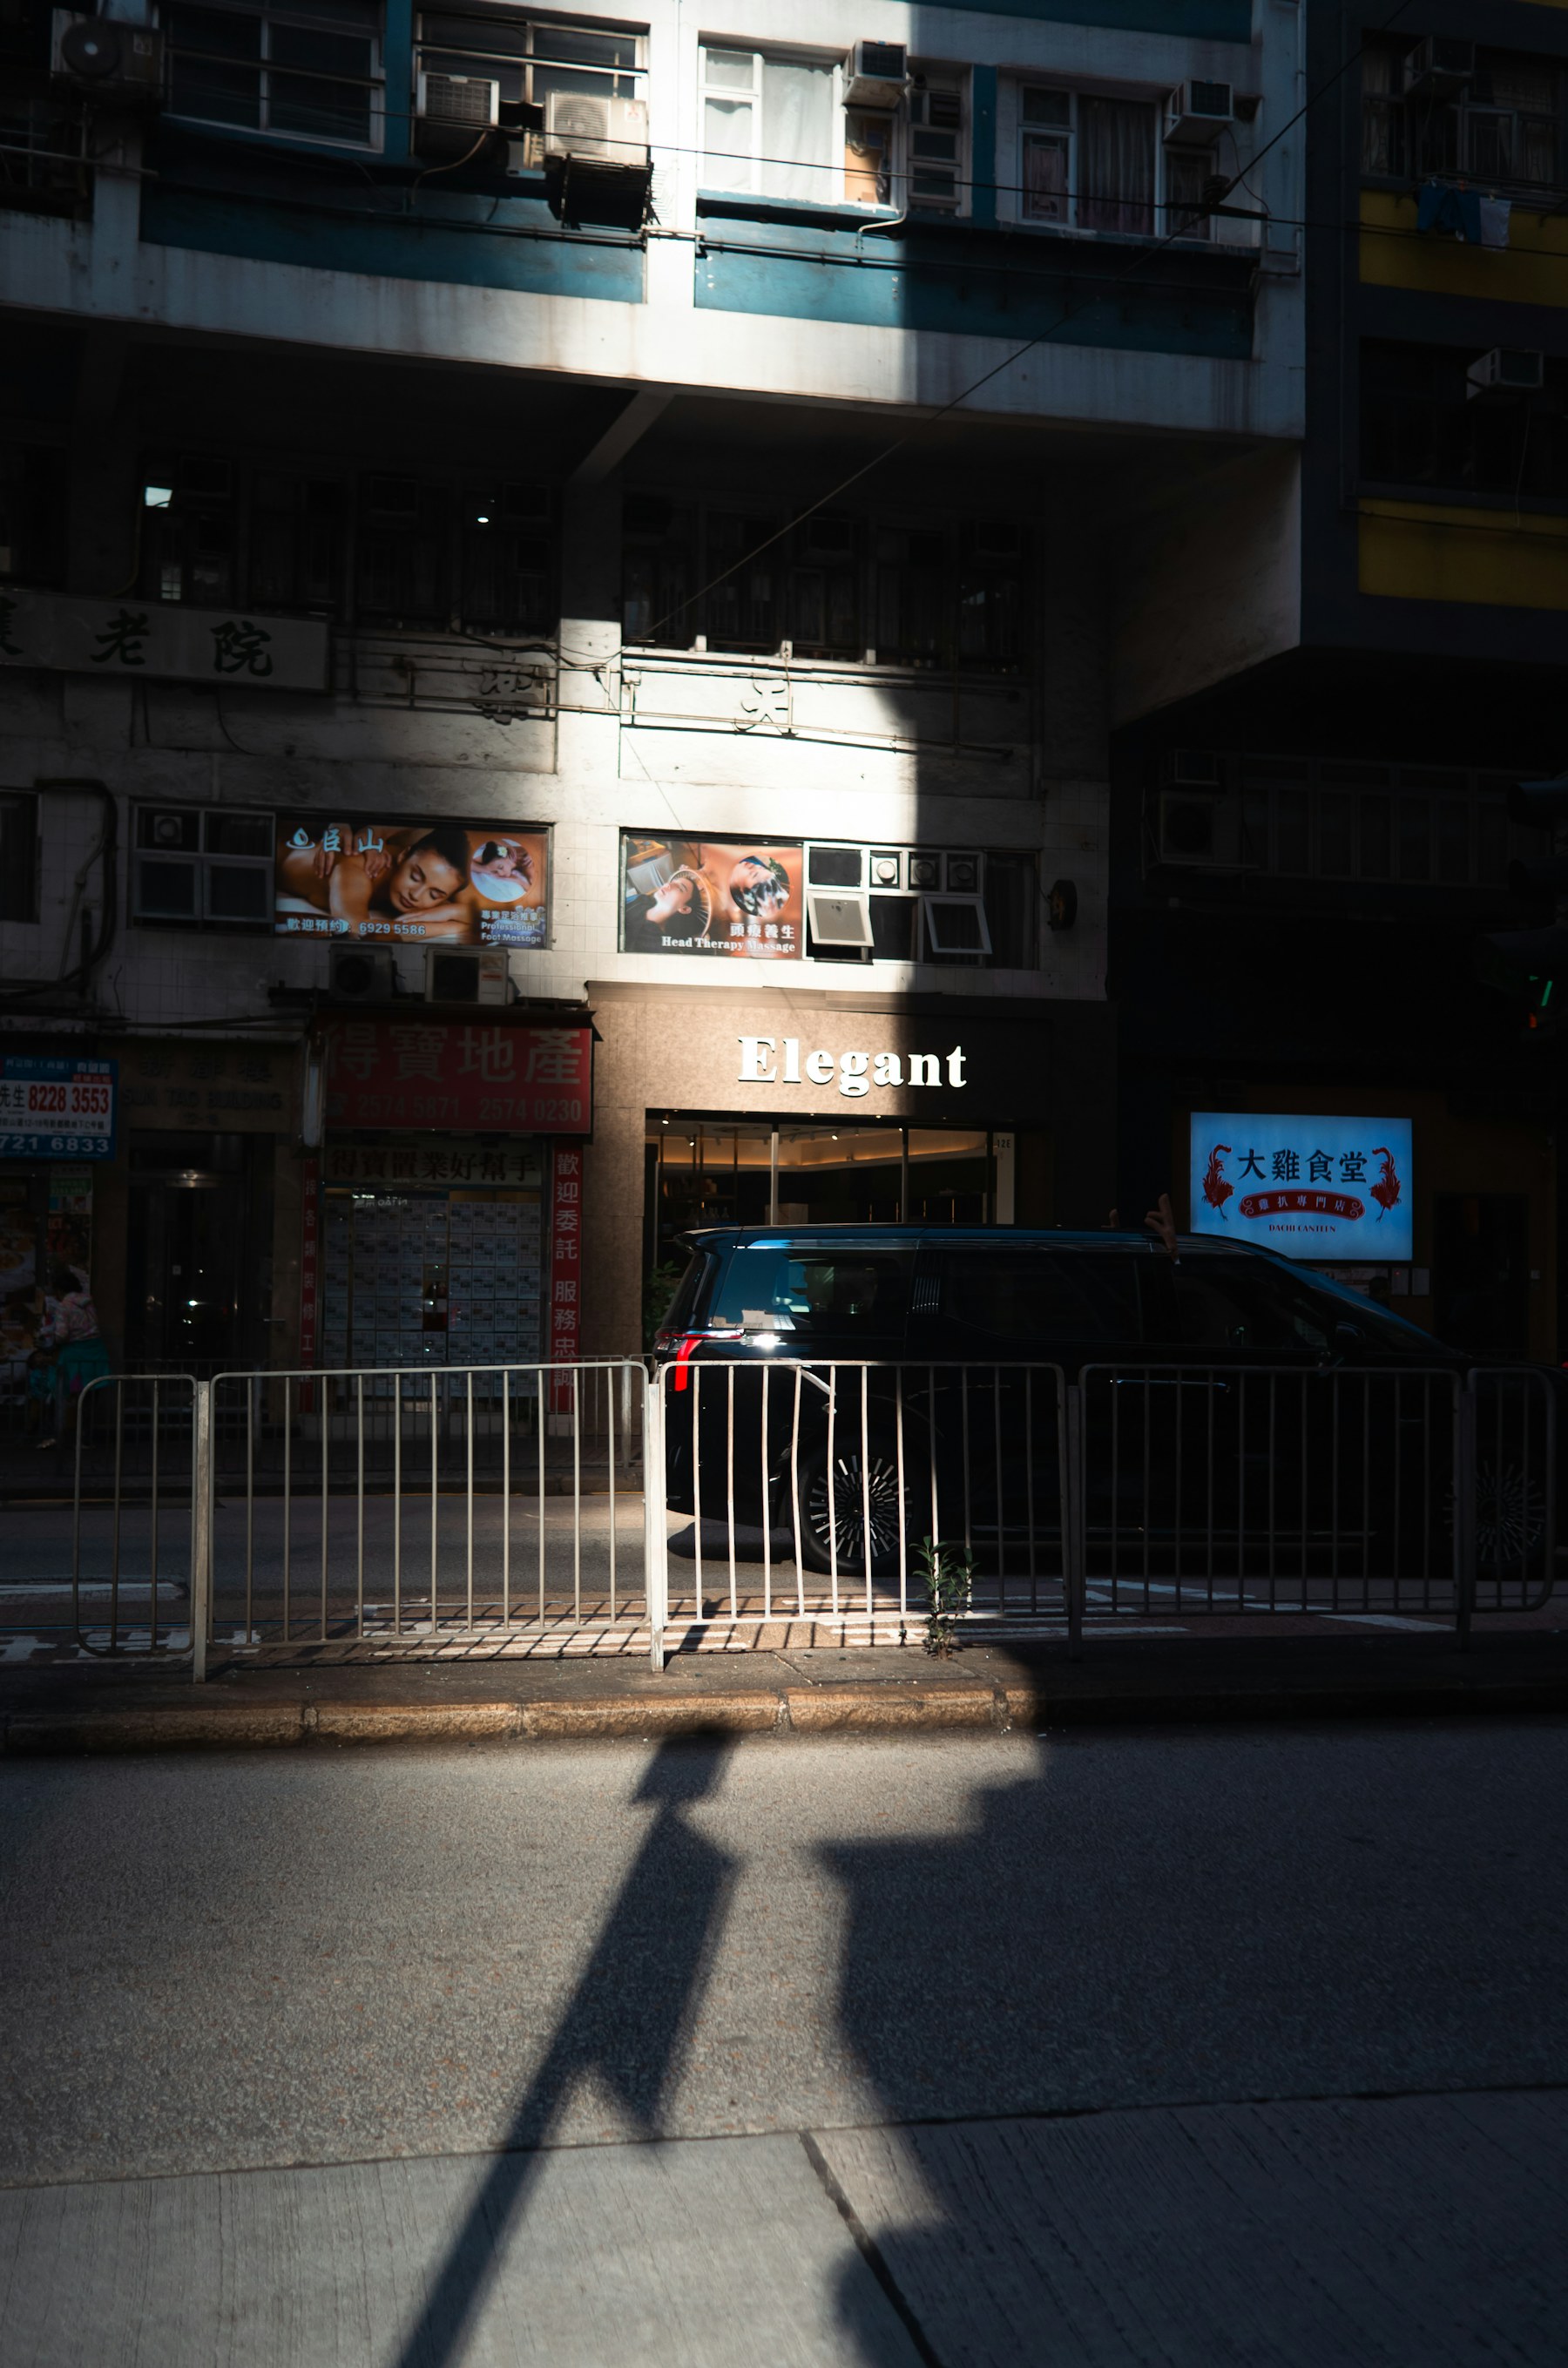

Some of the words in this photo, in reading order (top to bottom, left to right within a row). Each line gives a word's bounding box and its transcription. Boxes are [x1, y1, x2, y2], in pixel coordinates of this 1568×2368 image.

[359, 922, 391, 934] 6929
[394, 924, 426, 936] 5586
[481, 922, 535, 931] Professional
[481, 932, 501, 941] Foot
[503, 934, 541, 944] Massage
[662, 936, 693, 948] Head
[694, 937, 743, 952] Therapy
[747, 940, 795, 953] Massage
[325, 1023, 583, 1085] 得寶地產
[738, 1036, 967, 1098] Elegant
[28, 1085, 67, 1113] 8228
[71, 1086, 109, 1114] 3553
[208, 1091, 282, 1110] BUILDING
[357, 1093, 405, 1118] 2574
[414, 1095, 459, 1119] 5871
[480, 1098, 527, 1120] 2574
[534, 1099, 582, 1122] 0230
[51, 1137, 109, 1153] 6833
[1238, 1148, 1368, 1183] 大雞食堂
[556, 1153, 578, 1261] 歡迎委託
[1298, 1224, 1336, 1233] CANTEEN
[301, 1158, 317, 1383] 接各類裝修工
[554, 1280, 578, 1388] 服務忠誠
